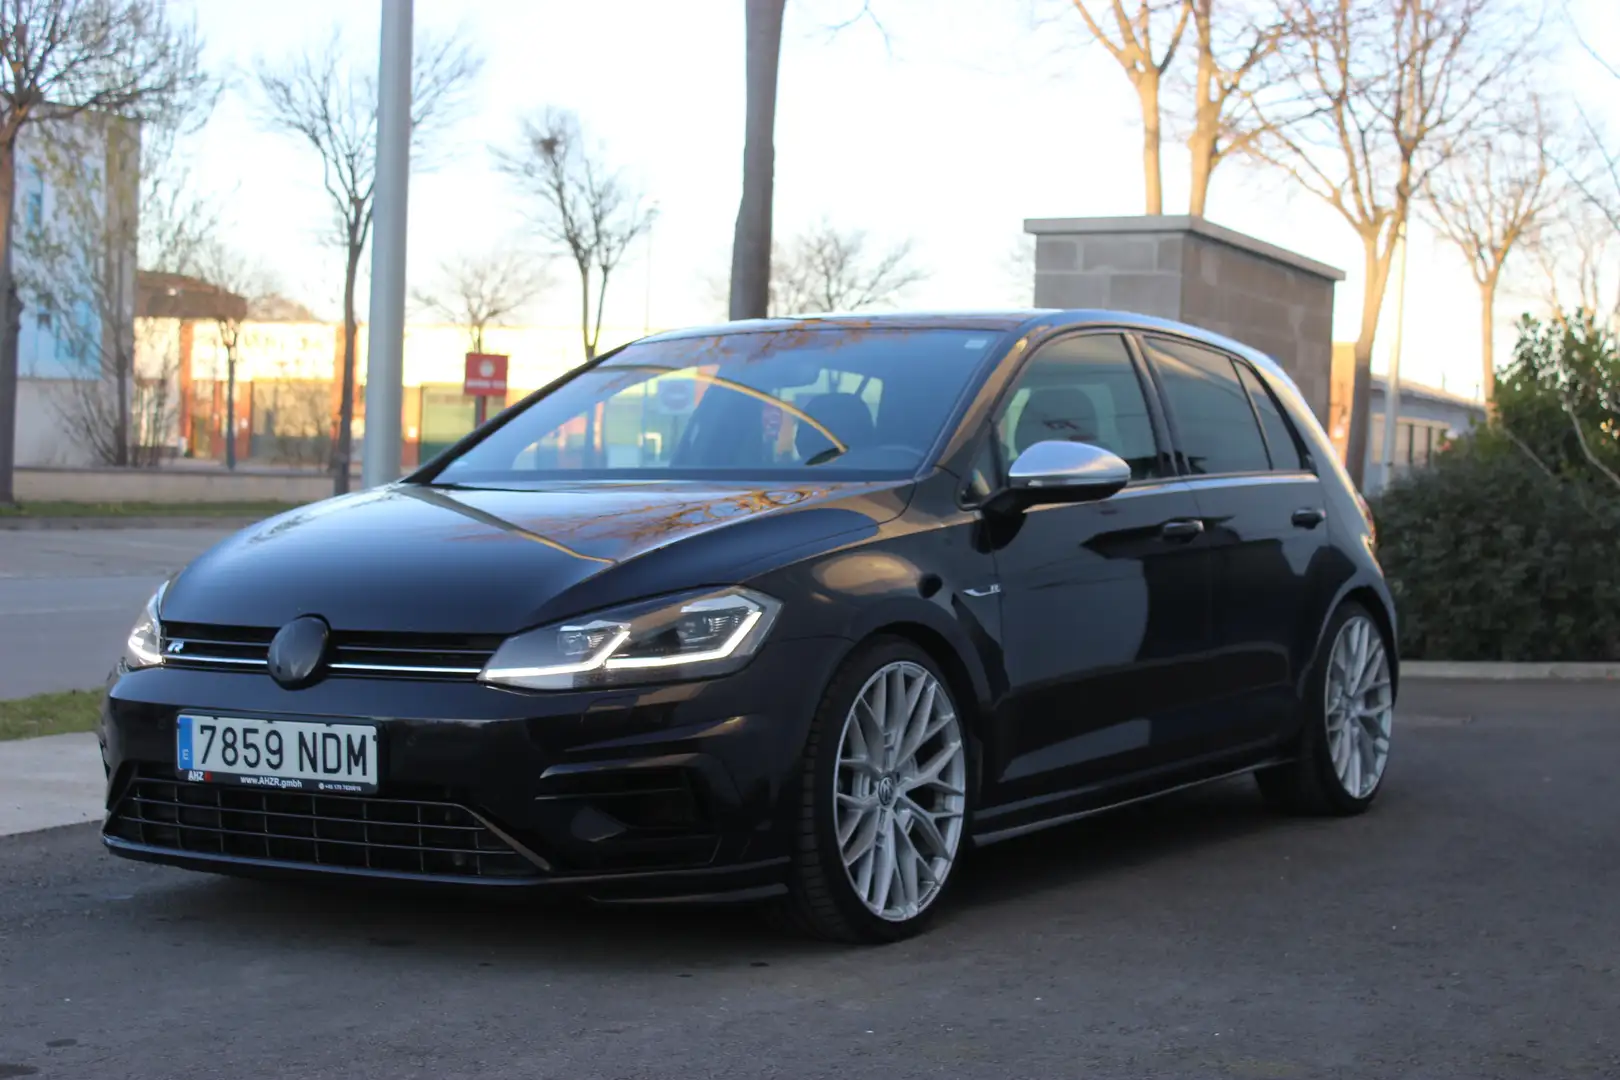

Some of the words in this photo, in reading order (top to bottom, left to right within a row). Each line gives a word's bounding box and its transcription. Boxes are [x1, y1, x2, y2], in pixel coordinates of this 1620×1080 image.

[167, 639, 185, 653] R
[182, 749, 189, 760] E
[200, 725, 284, 770] 7859
[298, 731, 367, 776] NDM
